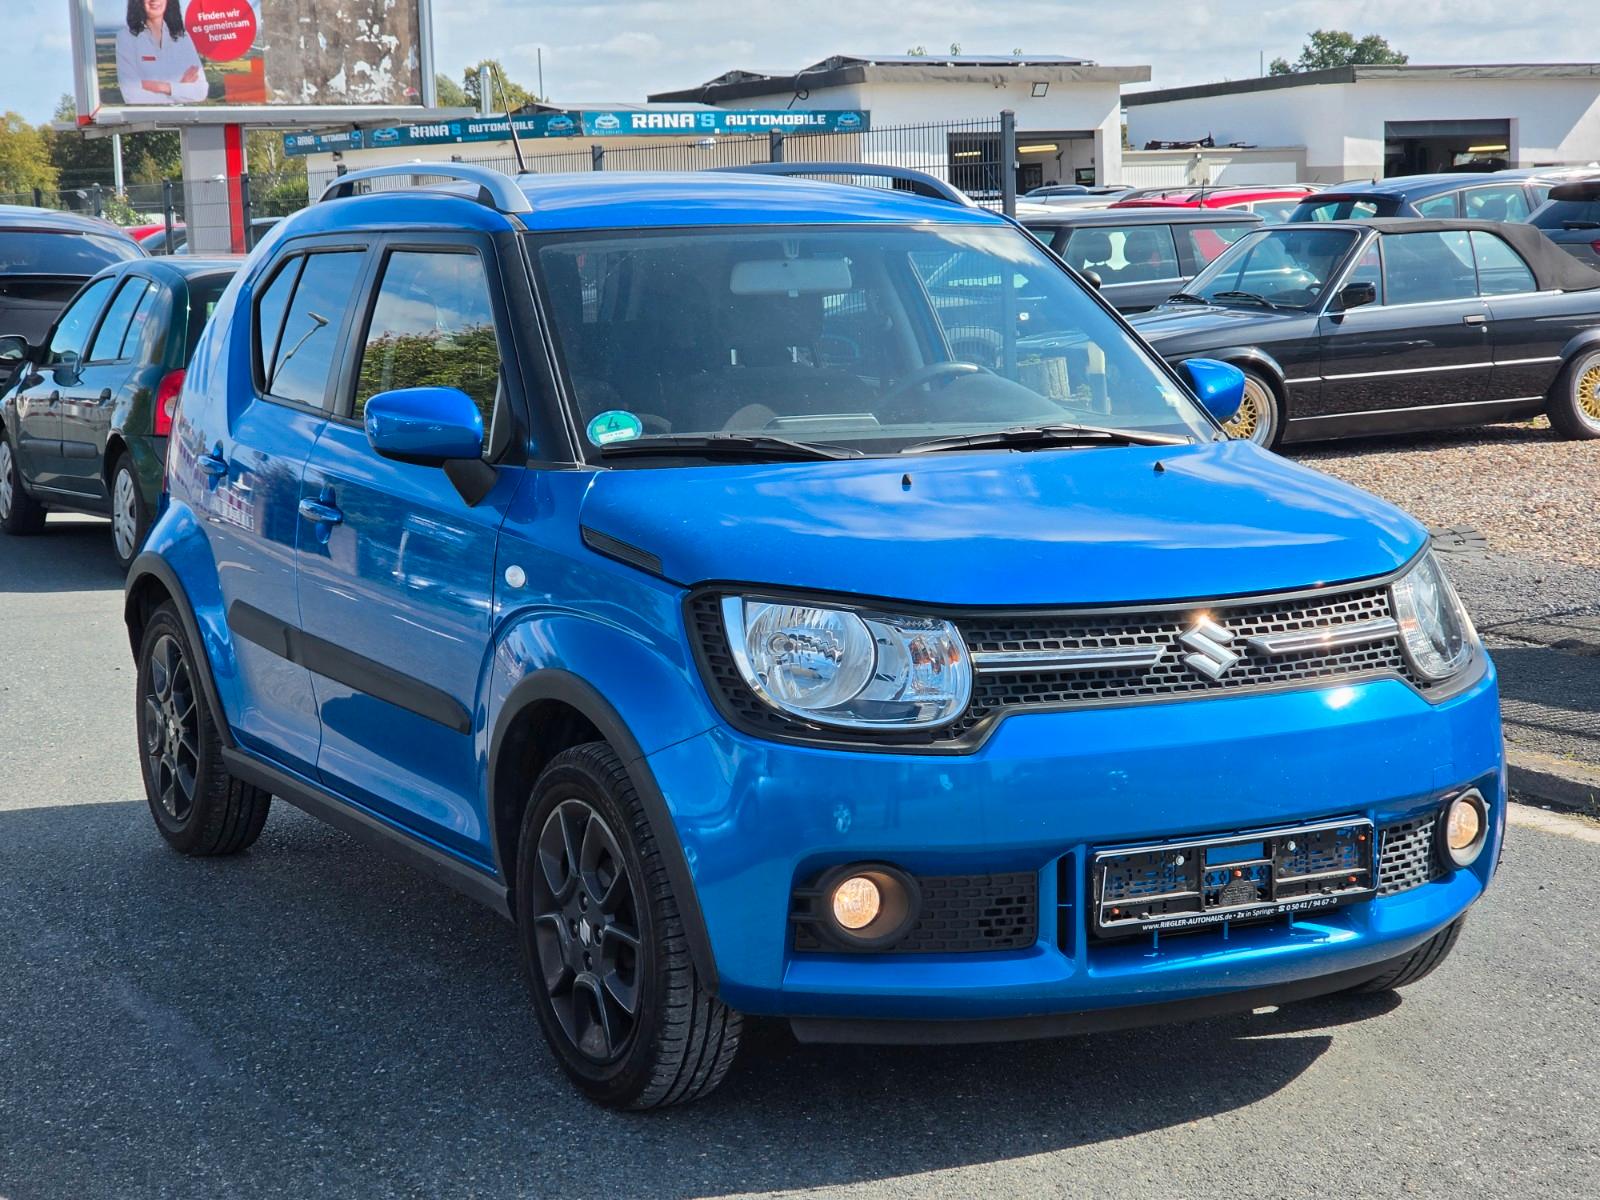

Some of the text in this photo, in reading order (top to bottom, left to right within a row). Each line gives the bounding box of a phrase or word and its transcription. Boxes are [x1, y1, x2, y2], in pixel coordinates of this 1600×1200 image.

[198, 8, 240, 21] Finden wir
[192, 20, 250, 33] es gemeinsam
[208, 32, 237, 42] heraus
[468, 120, 535, 133] AUTOMOBILE
[631, 113, 826, 129] RANA'S AUTOMOBILE
[607, 416, 620, 430] 4
[1142, 913, 1233, 931] www.RIEGLER-AUTOHAUS.de
[1252, 907, 1275, 917] Springe
